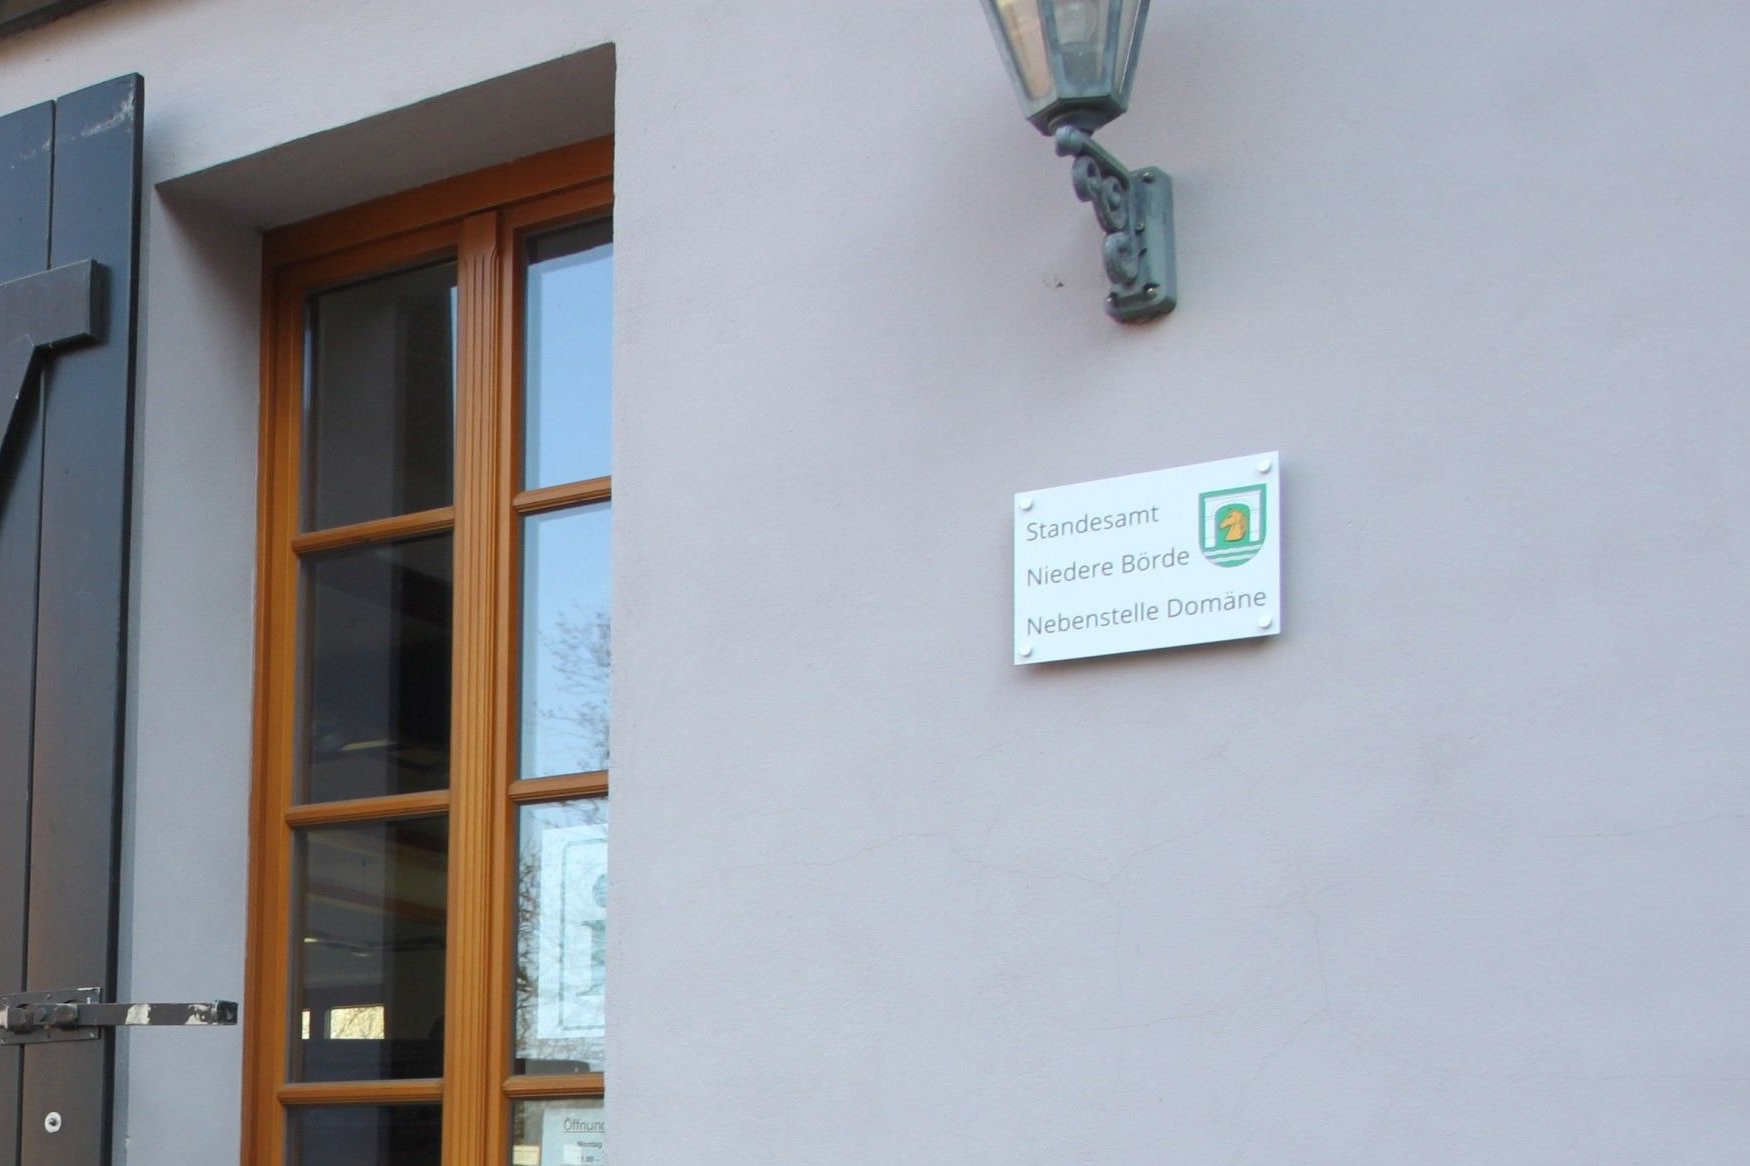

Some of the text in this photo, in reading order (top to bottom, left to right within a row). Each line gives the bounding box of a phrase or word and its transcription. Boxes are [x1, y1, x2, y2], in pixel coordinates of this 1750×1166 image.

[1026, 505, 1160, 541] Standesamt
[1026, 547, 1190, 587] Niedere Börde
[1026, 591, 1267, 636] Nebenstelle Domäne
